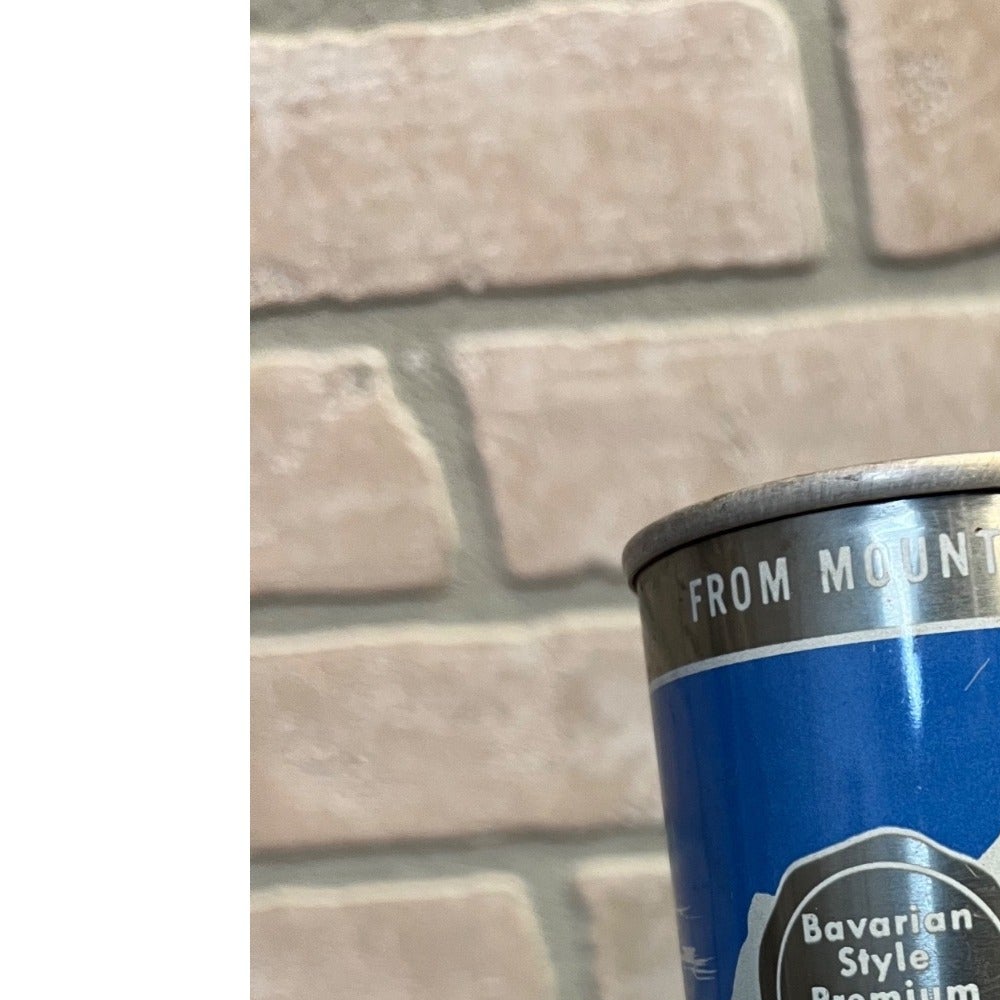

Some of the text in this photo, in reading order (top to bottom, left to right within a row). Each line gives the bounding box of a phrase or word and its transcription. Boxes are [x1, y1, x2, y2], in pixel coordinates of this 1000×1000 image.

[689, 558, 792, 623] FROM
[801, 905, 974, 944] Bavarian
[838, 941, 931, 982] Style
